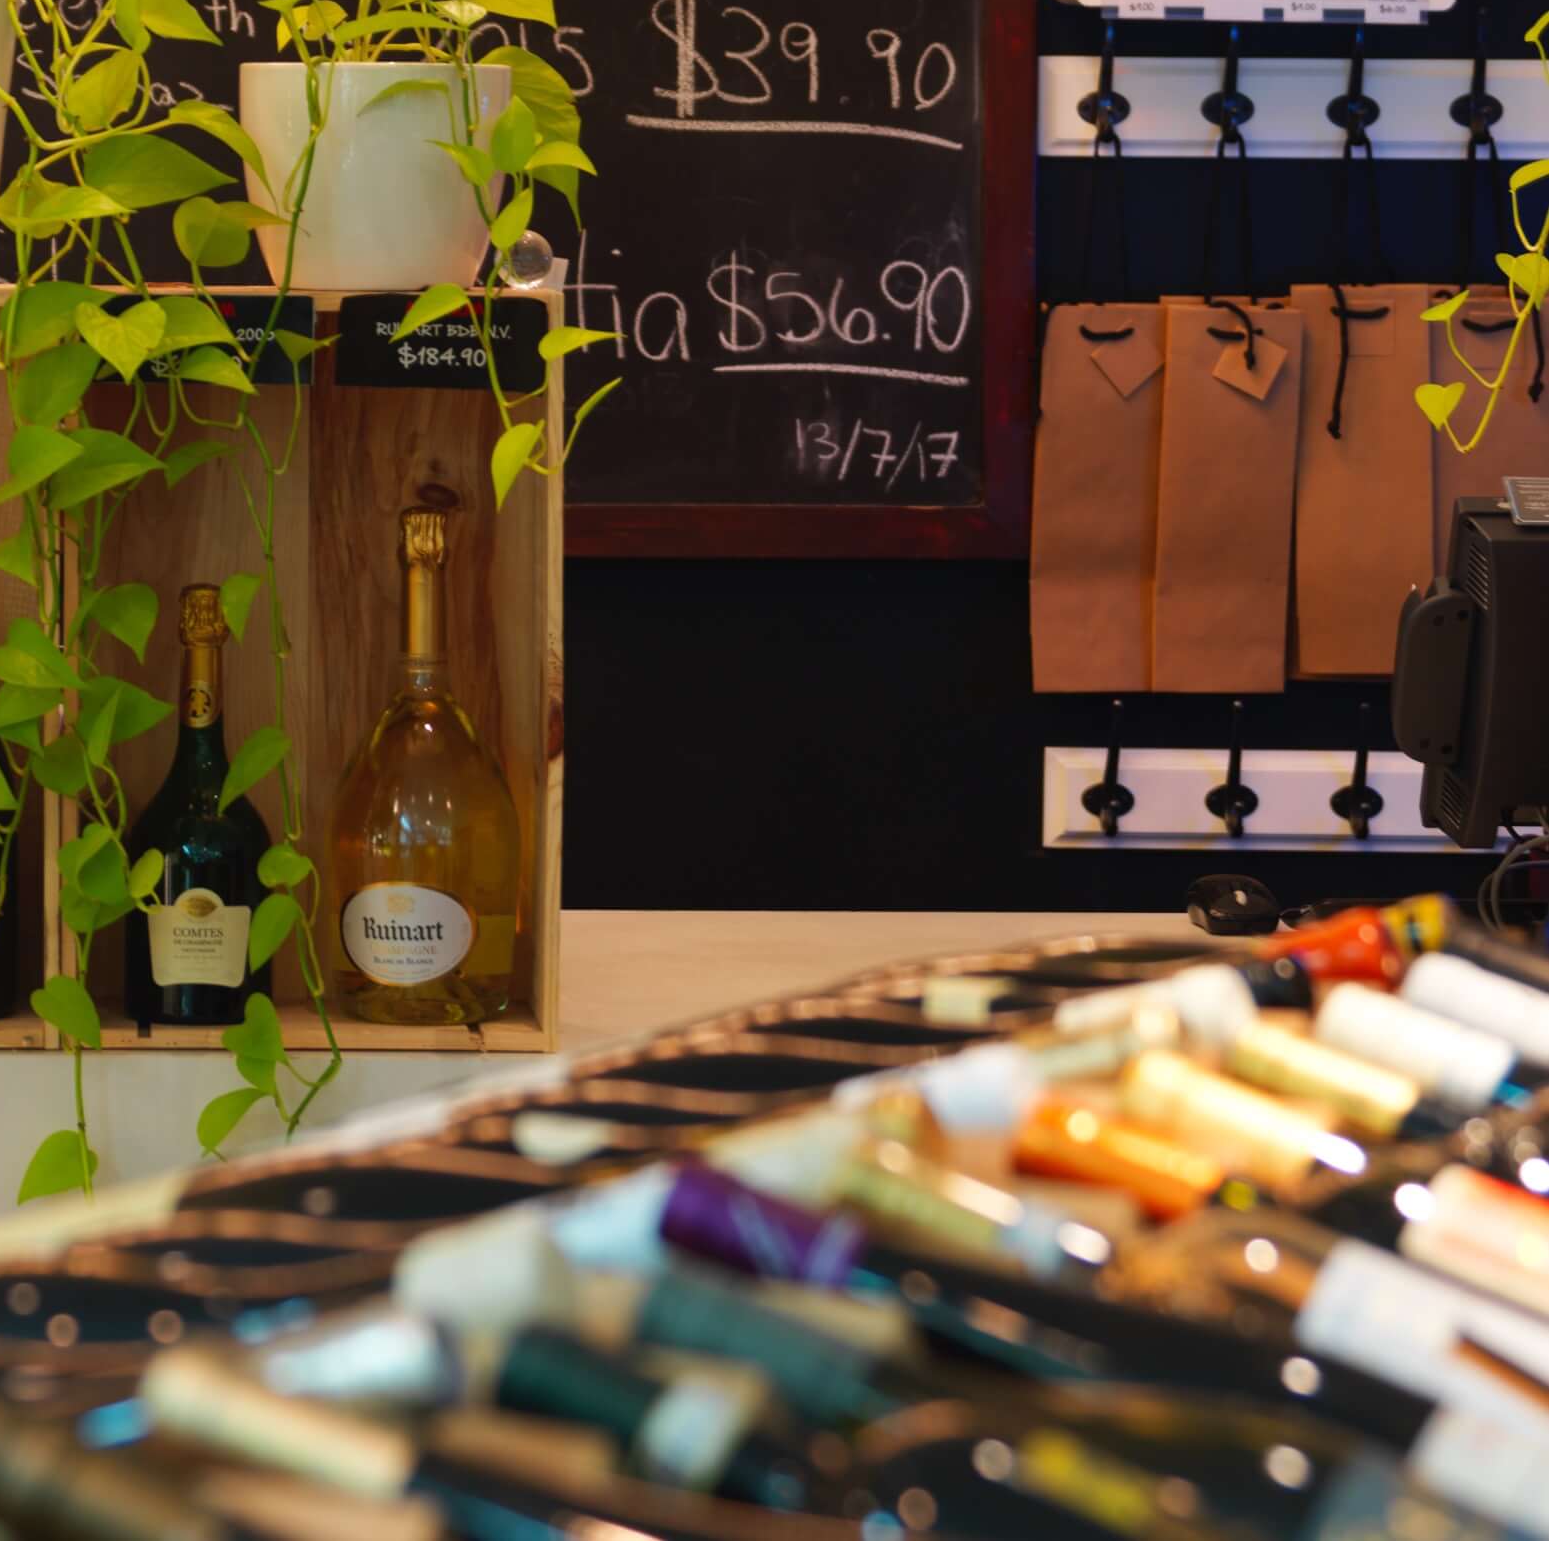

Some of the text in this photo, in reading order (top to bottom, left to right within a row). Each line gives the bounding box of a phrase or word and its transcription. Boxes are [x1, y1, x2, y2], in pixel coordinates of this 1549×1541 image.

[705, 249, 970, 353] $56.90
[396, 340, 487, 370] $184.90
[794, 416, 959, 493] 13/7/17
[172, 927, 224, 939] COMTES
[361, 916, 445, 942] Ruinart
